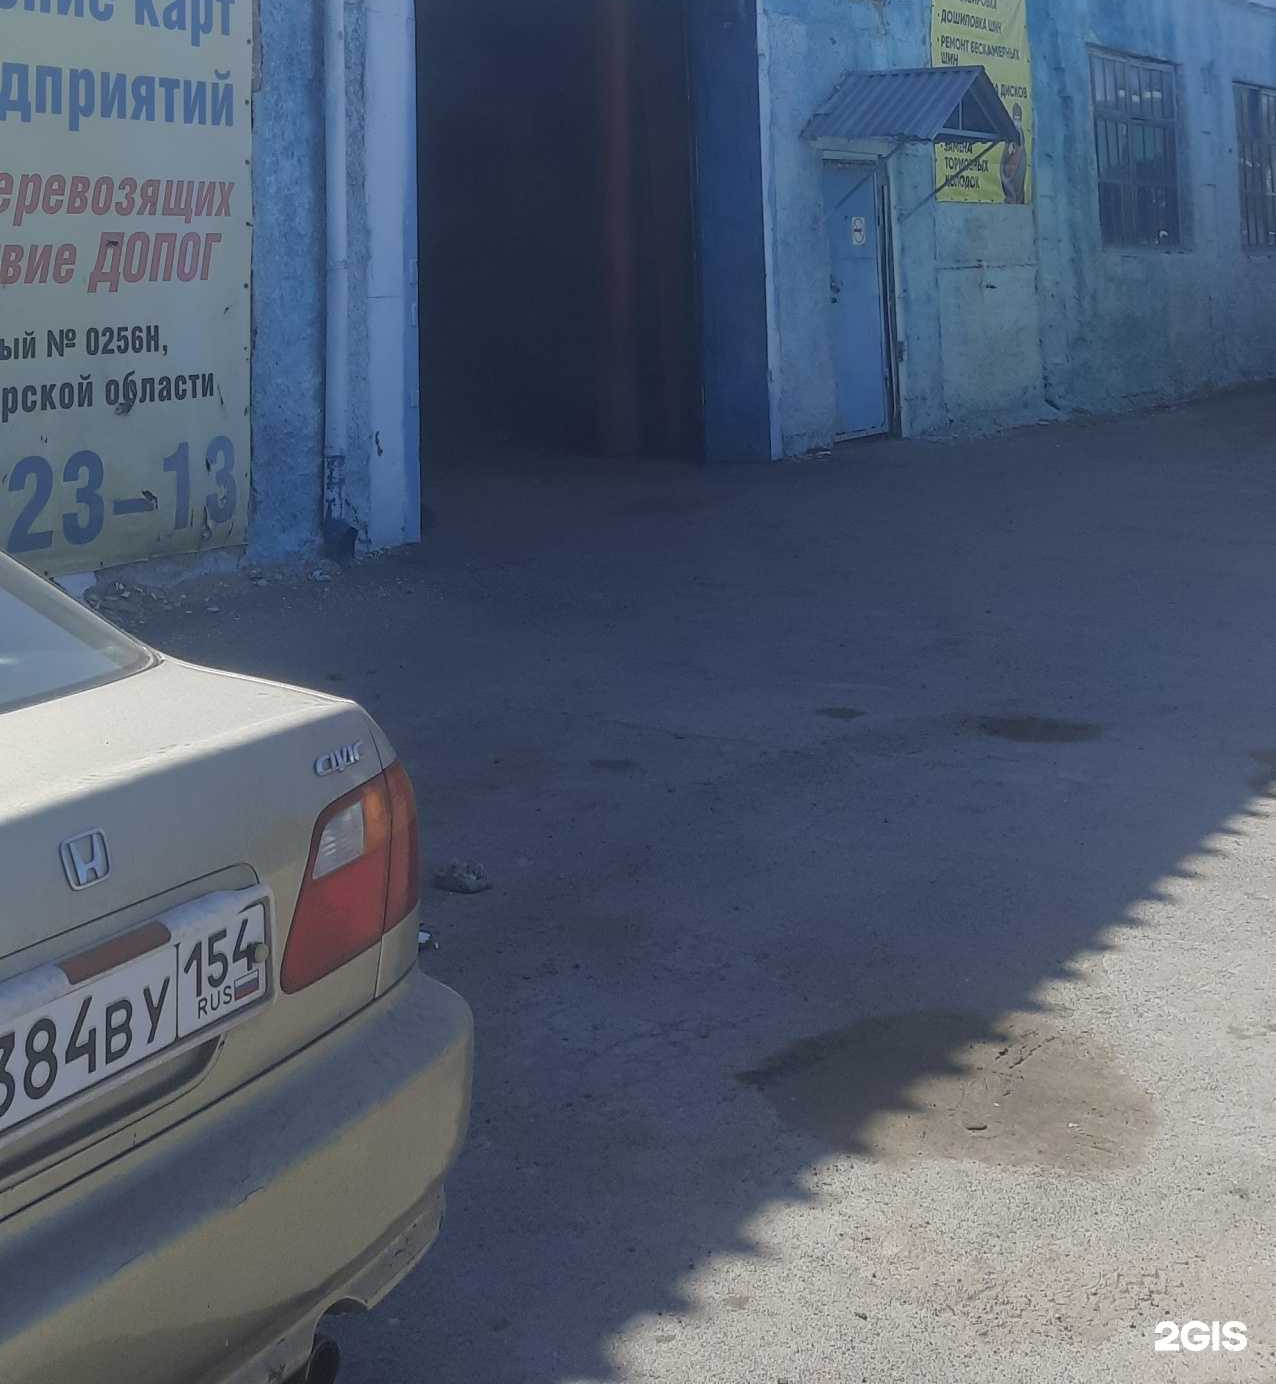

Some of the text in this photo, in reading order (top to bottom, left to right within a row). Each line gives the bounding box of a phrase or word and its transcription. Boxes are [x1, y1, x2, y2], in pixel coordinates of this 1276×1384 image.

[940, 34, 970, 54] РЕМОНТ
[941, 51, 959, 66] ШИН
[0, 62, 234, 131] дприятий
[0, 172, 234, 226] еревозящих
[0, 231, 222, 292] вие ДОПОГ
[86, 324, 168, 356] 0256Н,
[2, 371, 214, 422] рской области
[313, 740, 365, 776] CIVIC
[184, 918, 256, 998] 154
[198, 985, 233, 1019] RUS
